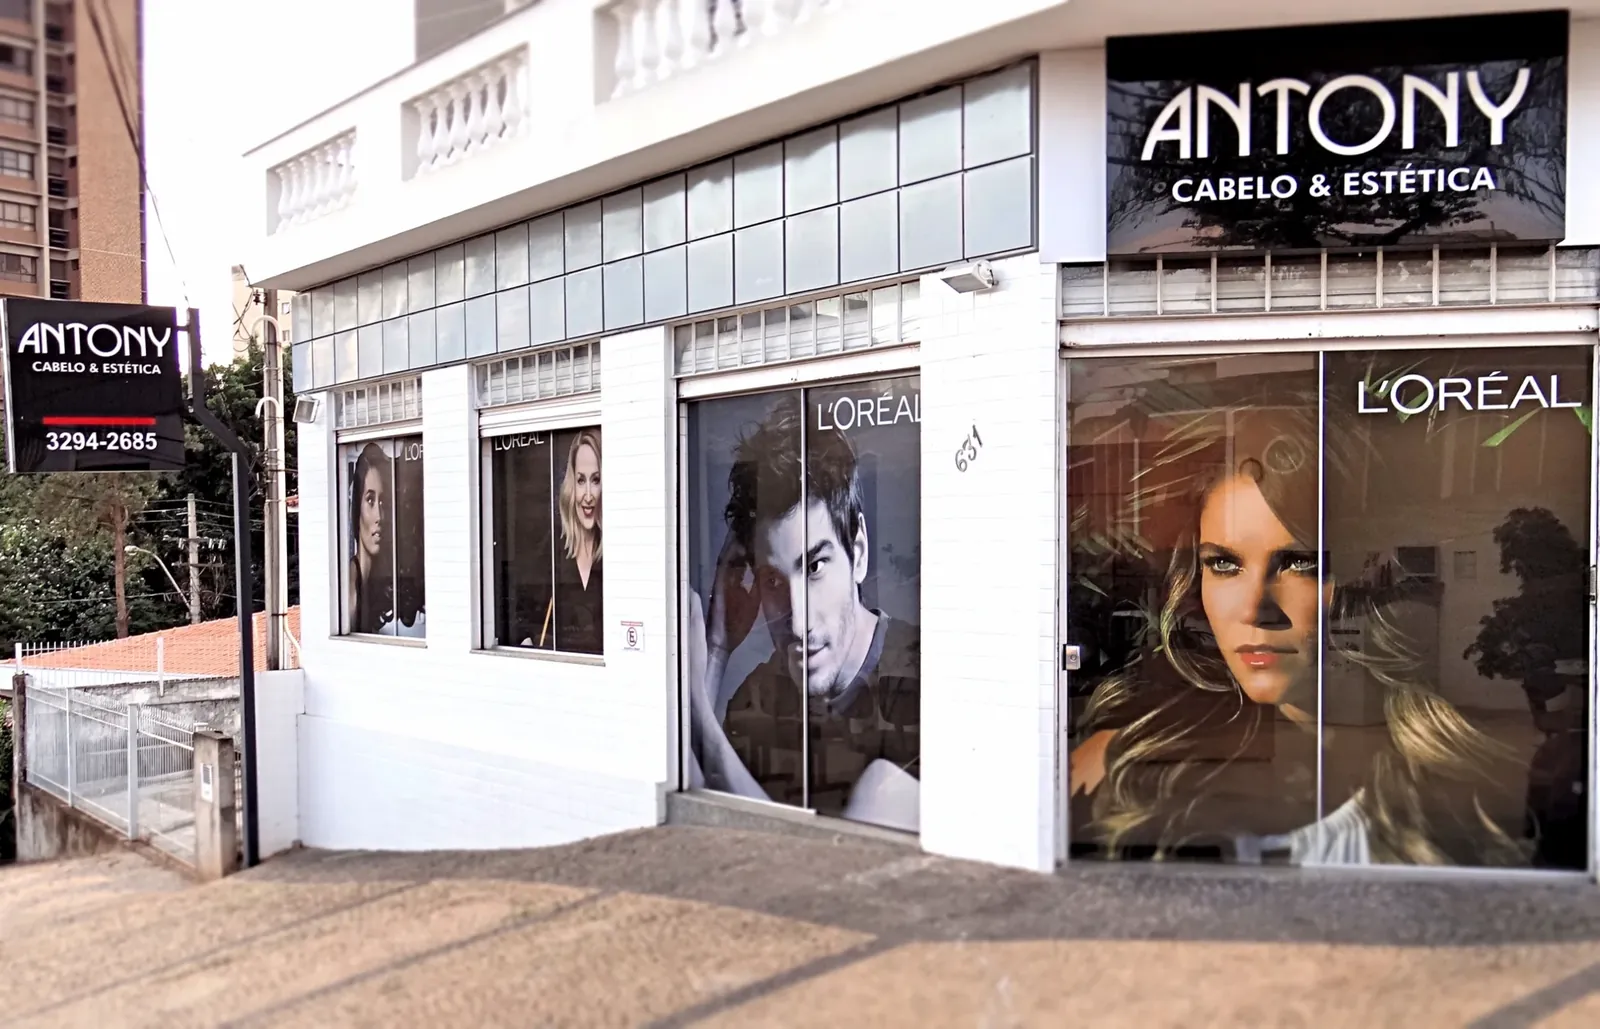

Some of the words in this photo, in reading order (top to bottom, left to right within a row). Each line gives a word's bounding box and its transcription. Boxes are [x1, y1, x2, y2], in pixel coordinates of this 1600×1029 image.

[1140, 67, 1531, 162] ANTONY
[1172, 173, 1298, 202] CABELO
[1309, 173, 1331, 198] &
[1343, 163, 1496, 196] ESTÉTICA
[17, 322, 172, 358] ANTONY
[32, 360, 86, 373] CABELO
[89, 362, 99, 373] &
[102, 360, 162, 375] ESTÉTICA
[817, 392, 922, 431] L'ORÉAL
[1357, 371, 1582, 414] L'ORÉAL
[46, 431, 158, 451] 3294-2685
